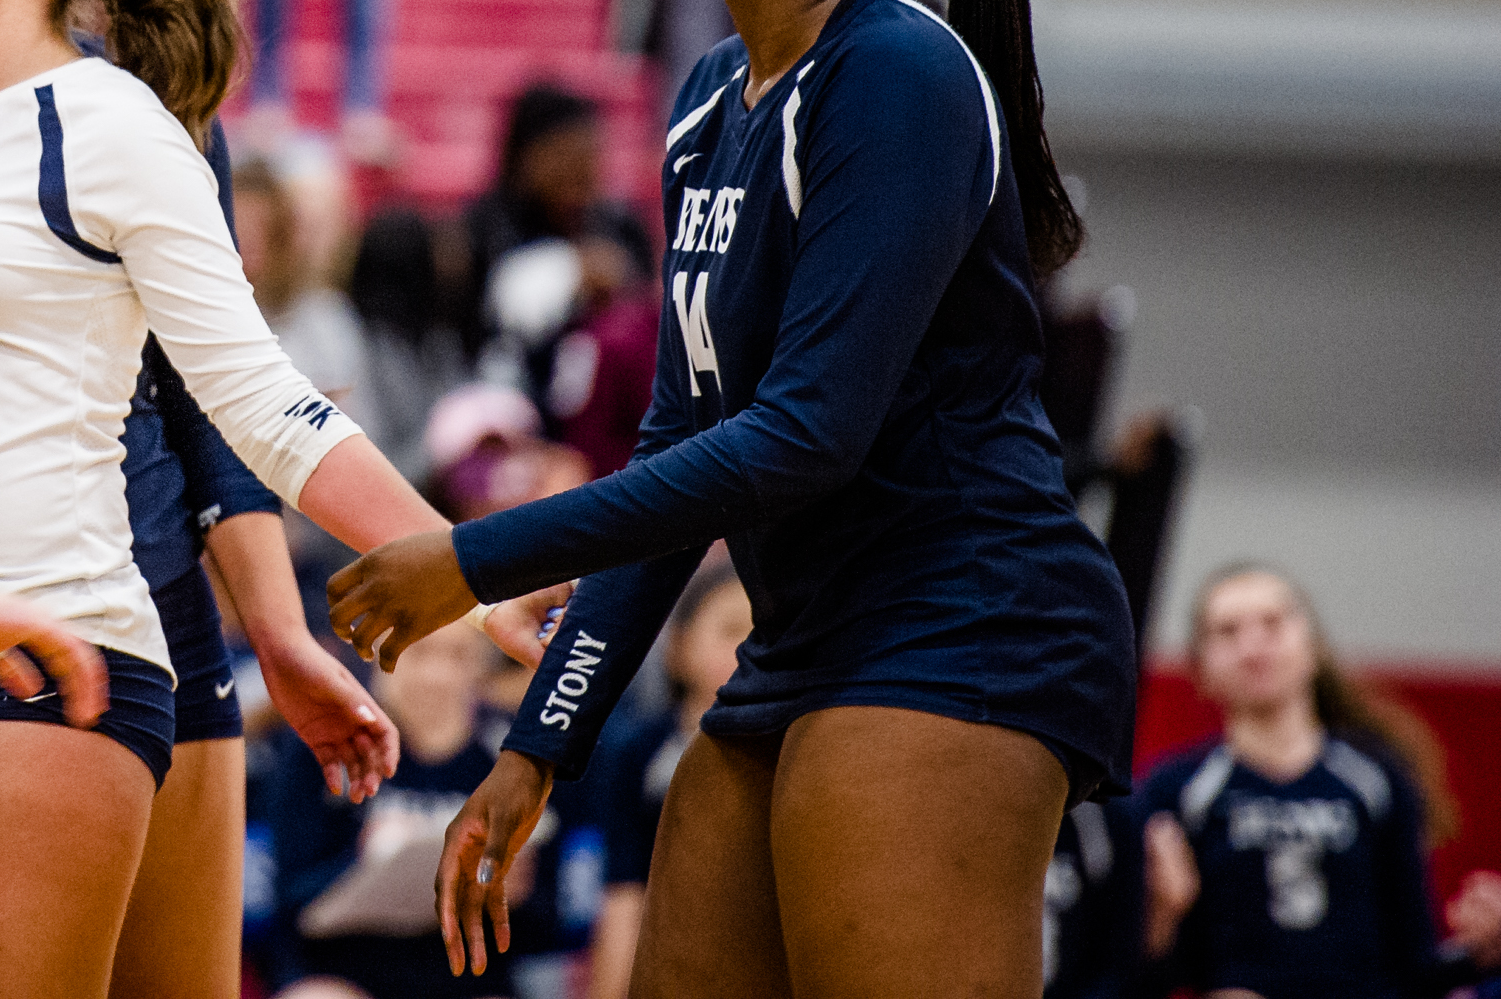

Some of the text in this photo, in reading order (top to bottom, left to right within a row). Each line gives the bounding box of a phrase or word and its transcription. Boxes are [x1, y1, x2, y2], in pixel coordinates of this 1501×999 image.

[672, 186, 746, 254] BEARS
[673, 271, 723, 397] 14
[540, 630, 608, 731] STONY
